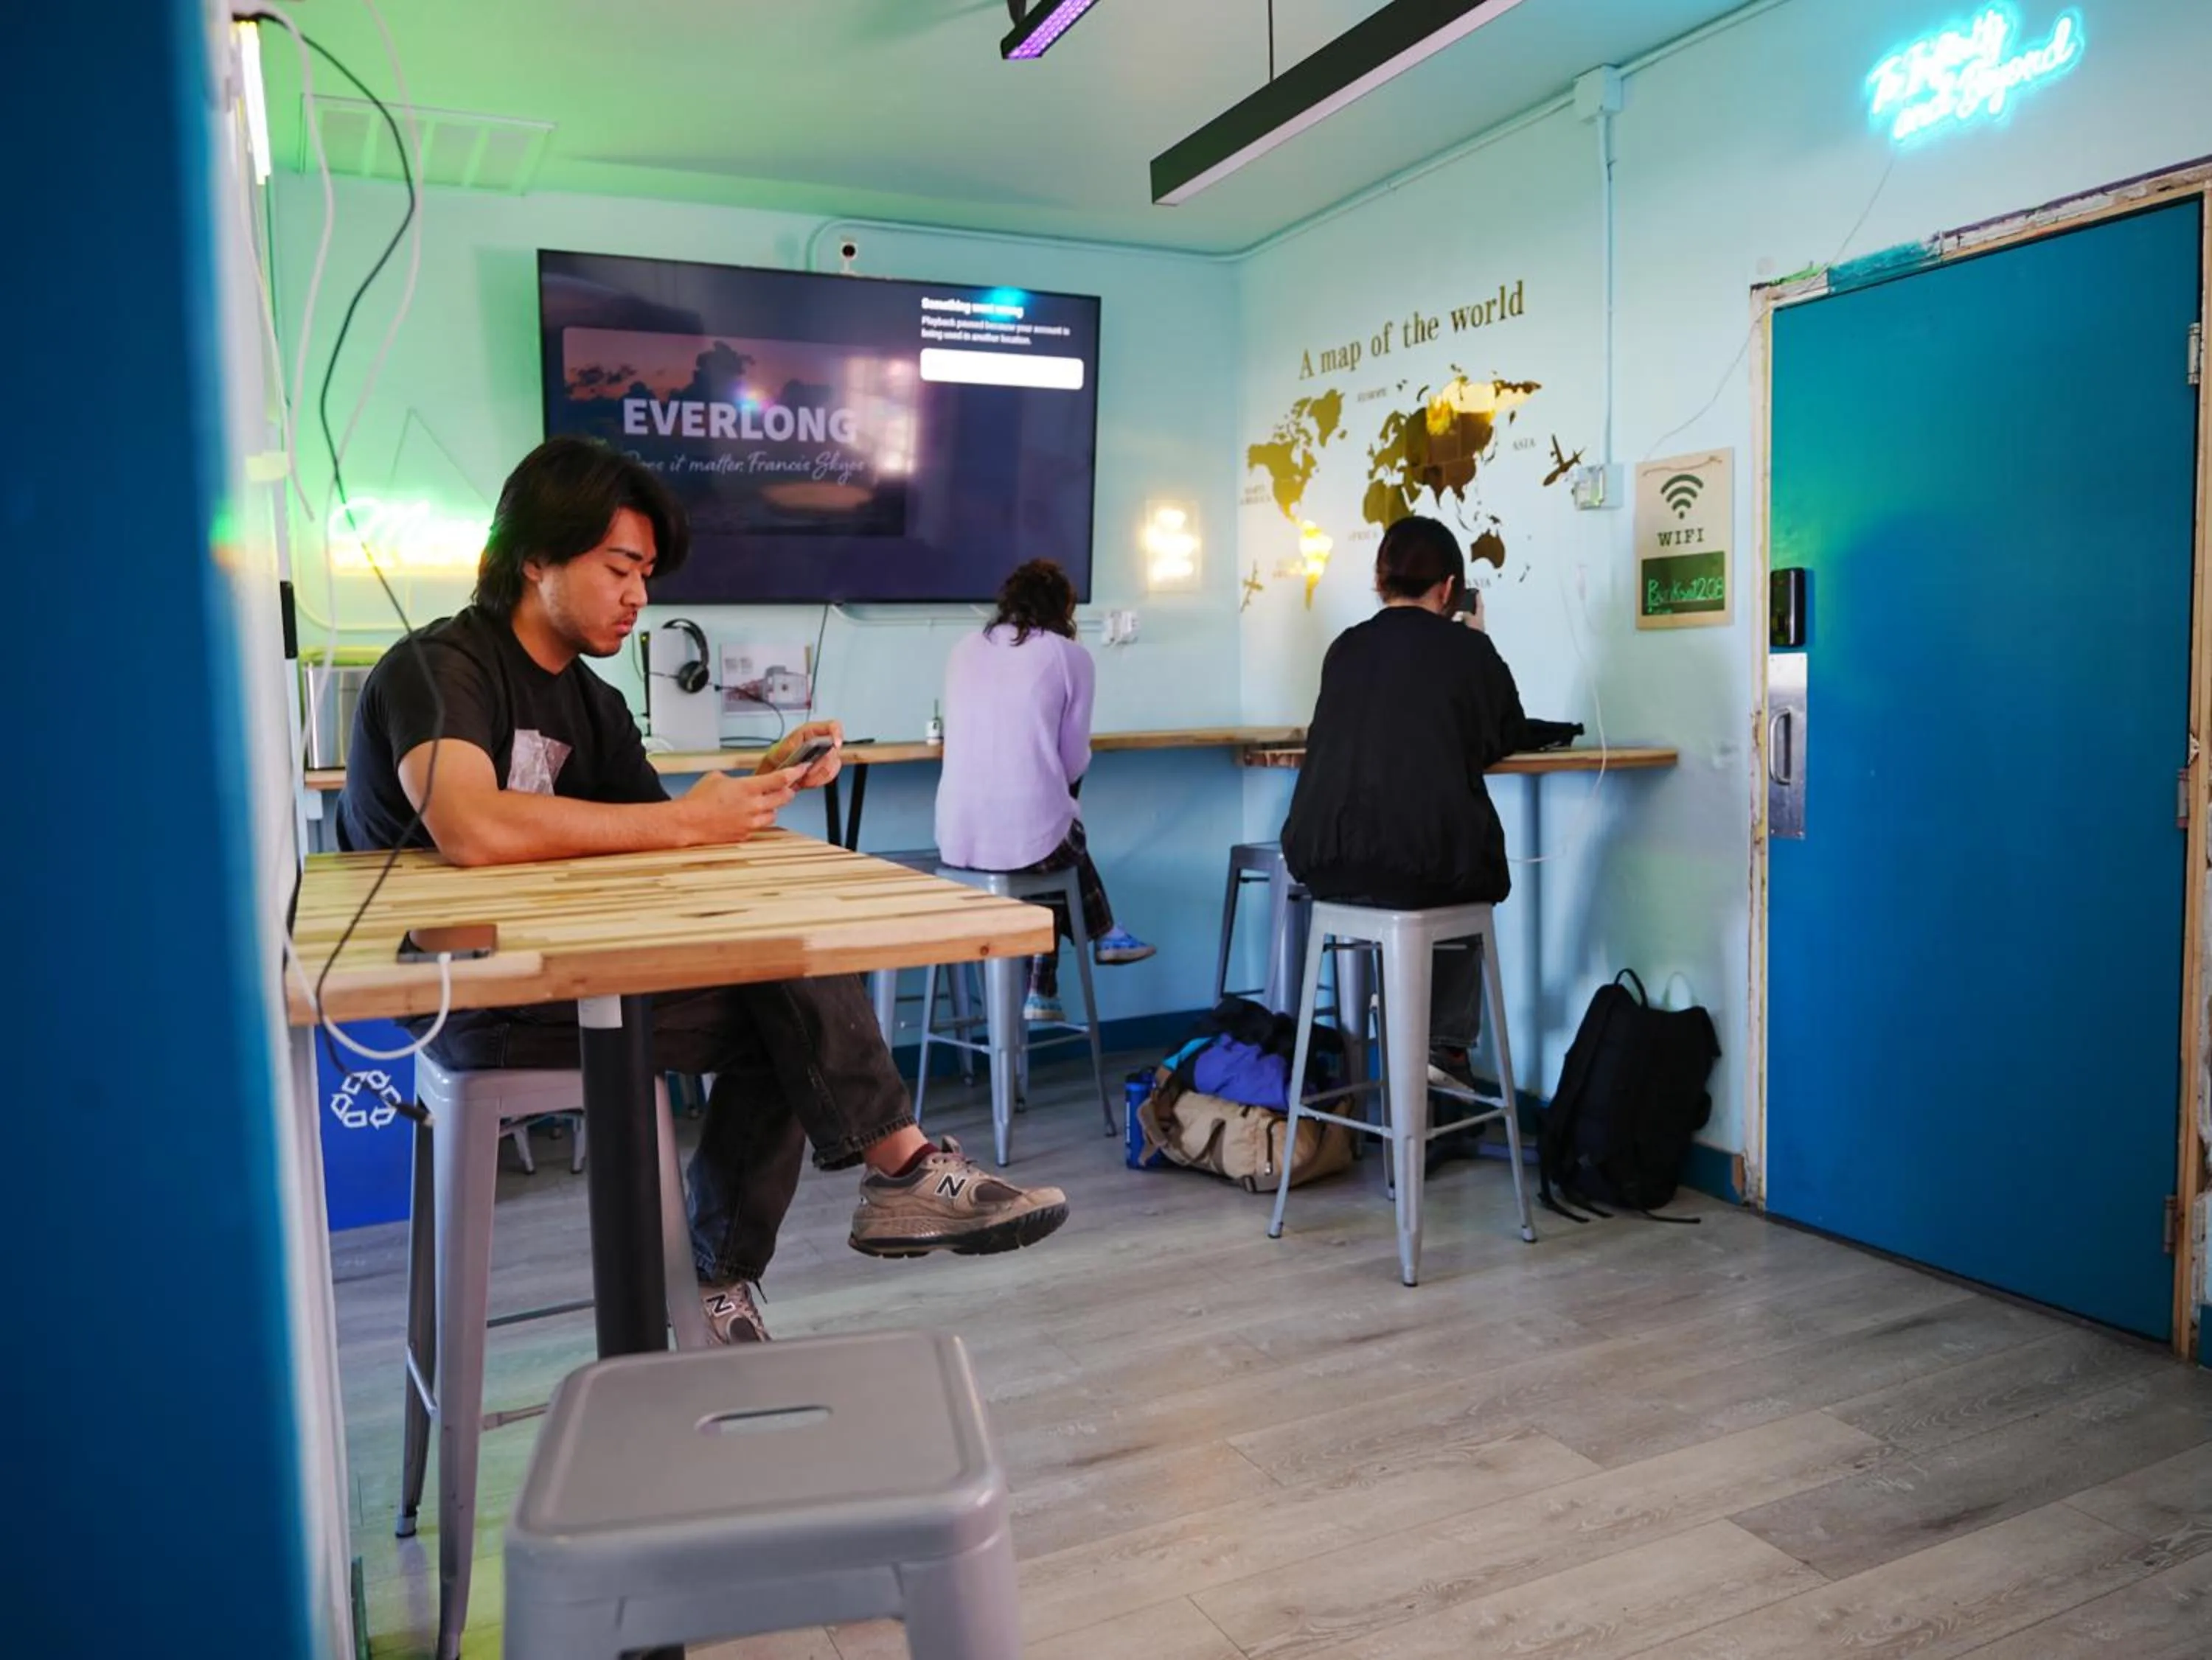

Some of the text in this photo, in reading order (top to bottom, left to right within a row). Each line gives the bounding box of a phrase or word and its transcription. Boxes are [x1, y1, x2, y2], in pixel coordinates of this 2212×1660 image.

[1299, 279, 1525, 380] A map of the world
[622, 397, 858, 443] EVERLONG
[747, 450, 811, 473] Francis
[1657, 527, 1705, 548] WIFI
